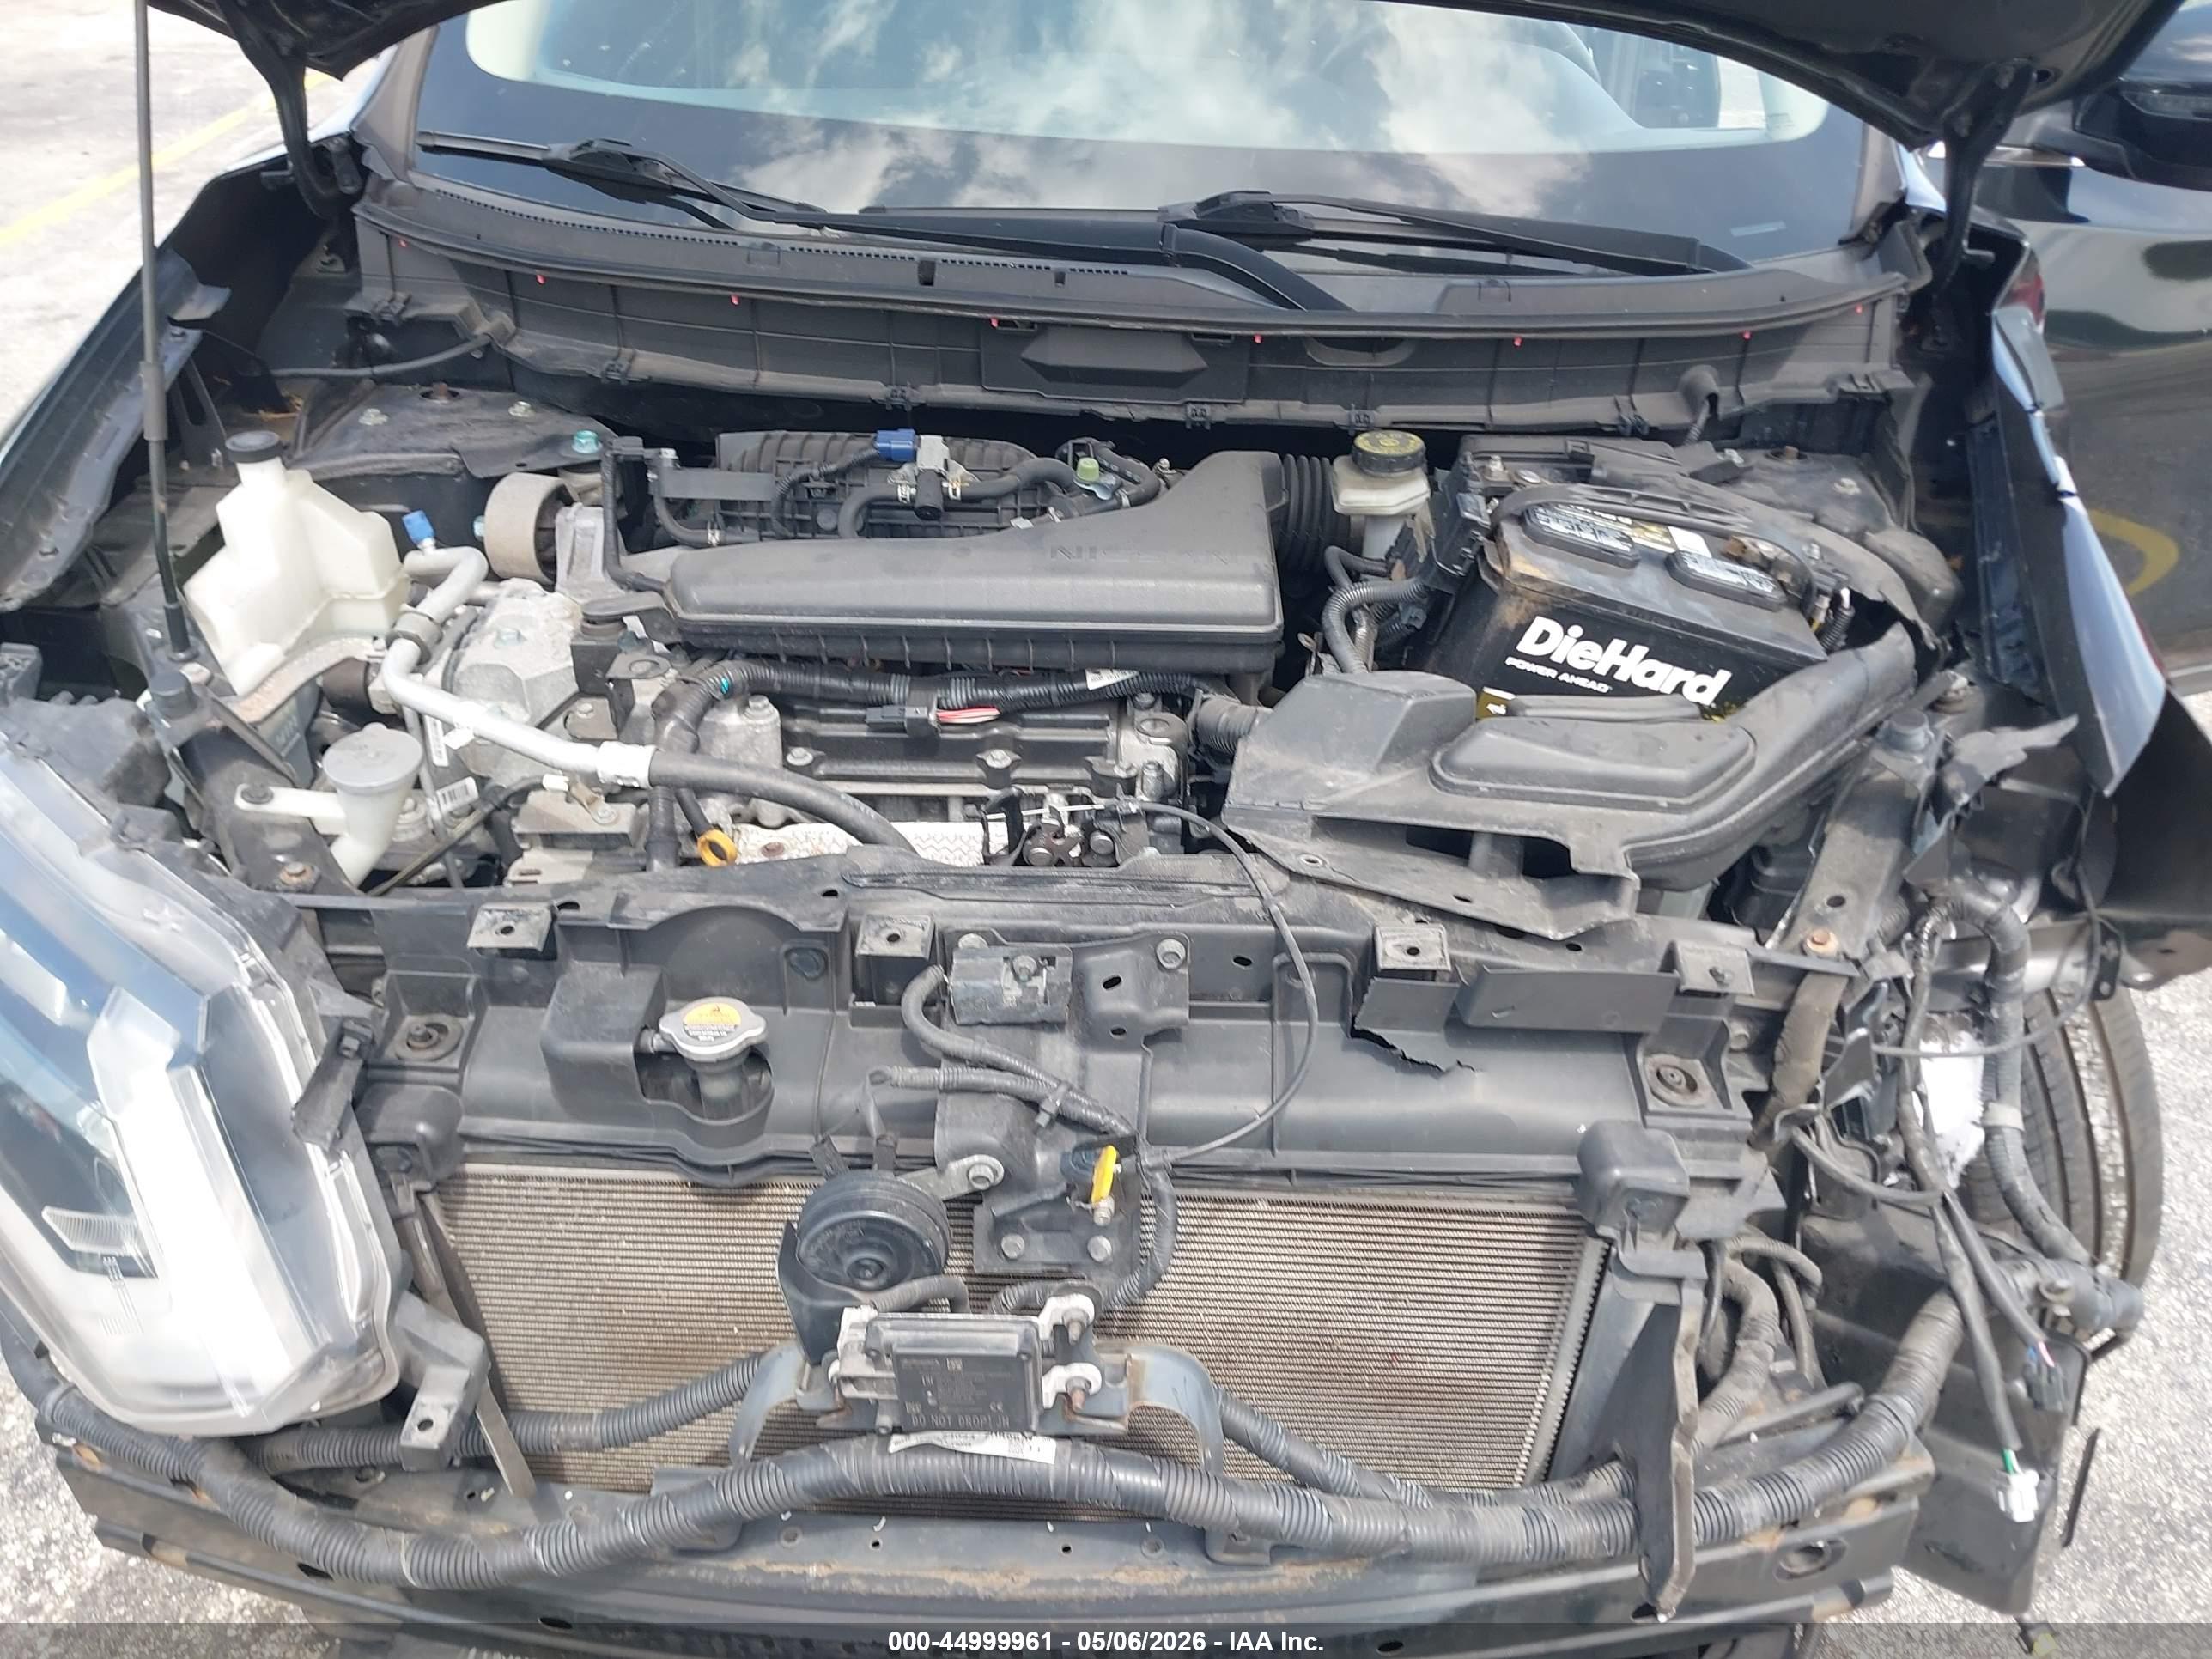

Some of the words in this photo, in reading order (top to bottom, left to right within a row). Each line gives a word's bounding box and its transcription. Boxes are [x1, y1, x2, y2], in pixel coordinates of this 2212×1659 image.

[1505, 657, 1558, 678] POWER
[1558, 672, 1610, 693] AHEAD
[1516, 616, 1732, 706] DieHard
[911, 1413, 927, 1428] DO
[930, 1414, 951, 1428] NOT
